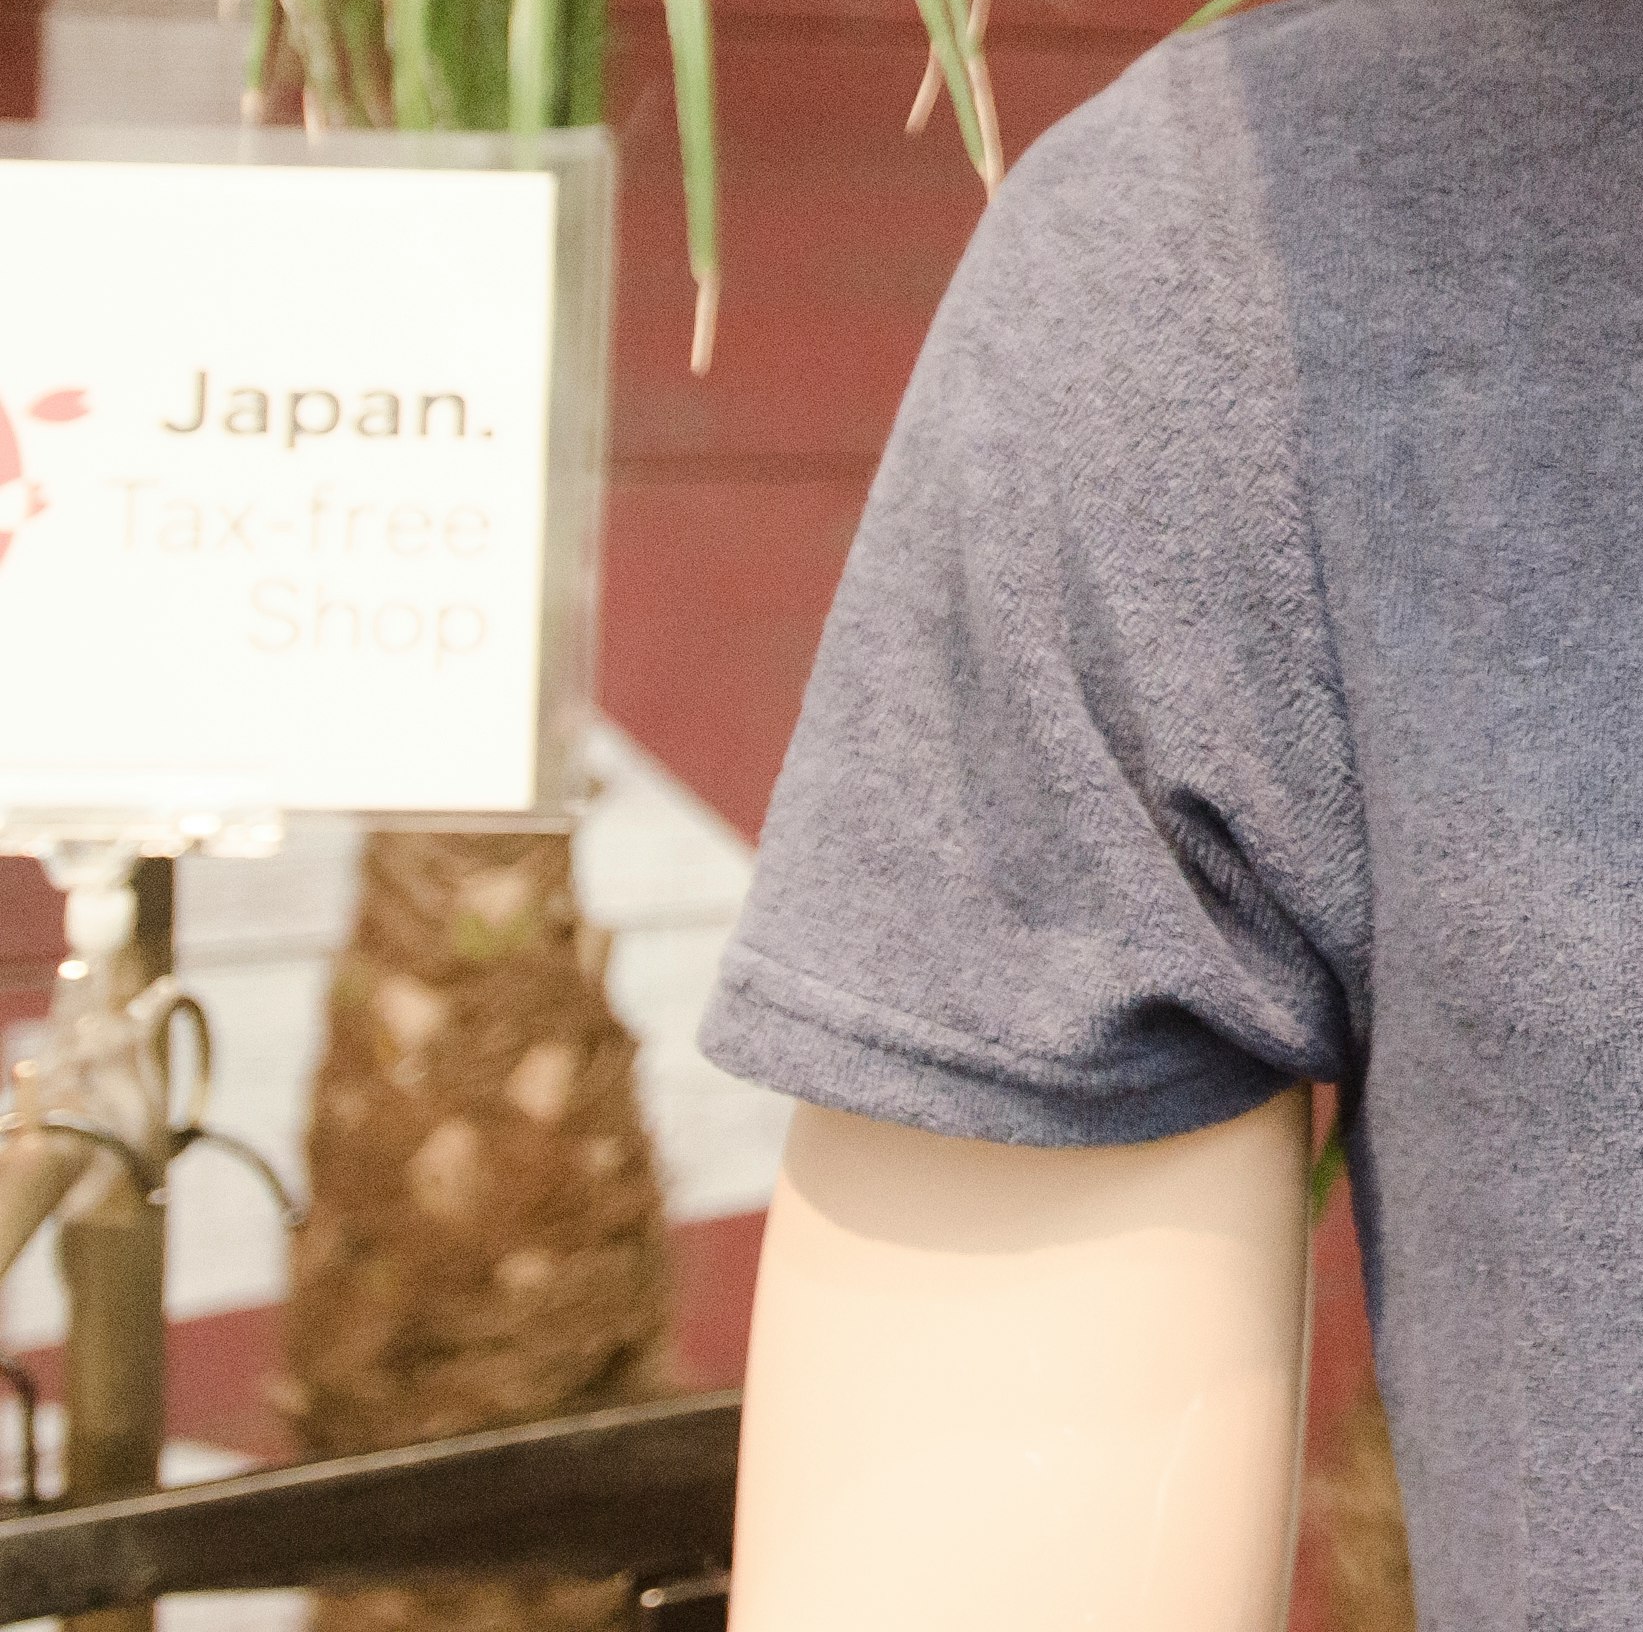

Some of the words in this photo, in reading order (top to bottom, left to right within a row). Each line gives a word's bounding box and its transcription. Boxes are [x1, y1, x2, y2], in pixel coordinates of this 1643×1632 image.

[160, 368, 495, 451] Japan.
[104, 476, 491, 558] Tax-free
[247, 576, 489, 671] Shop
